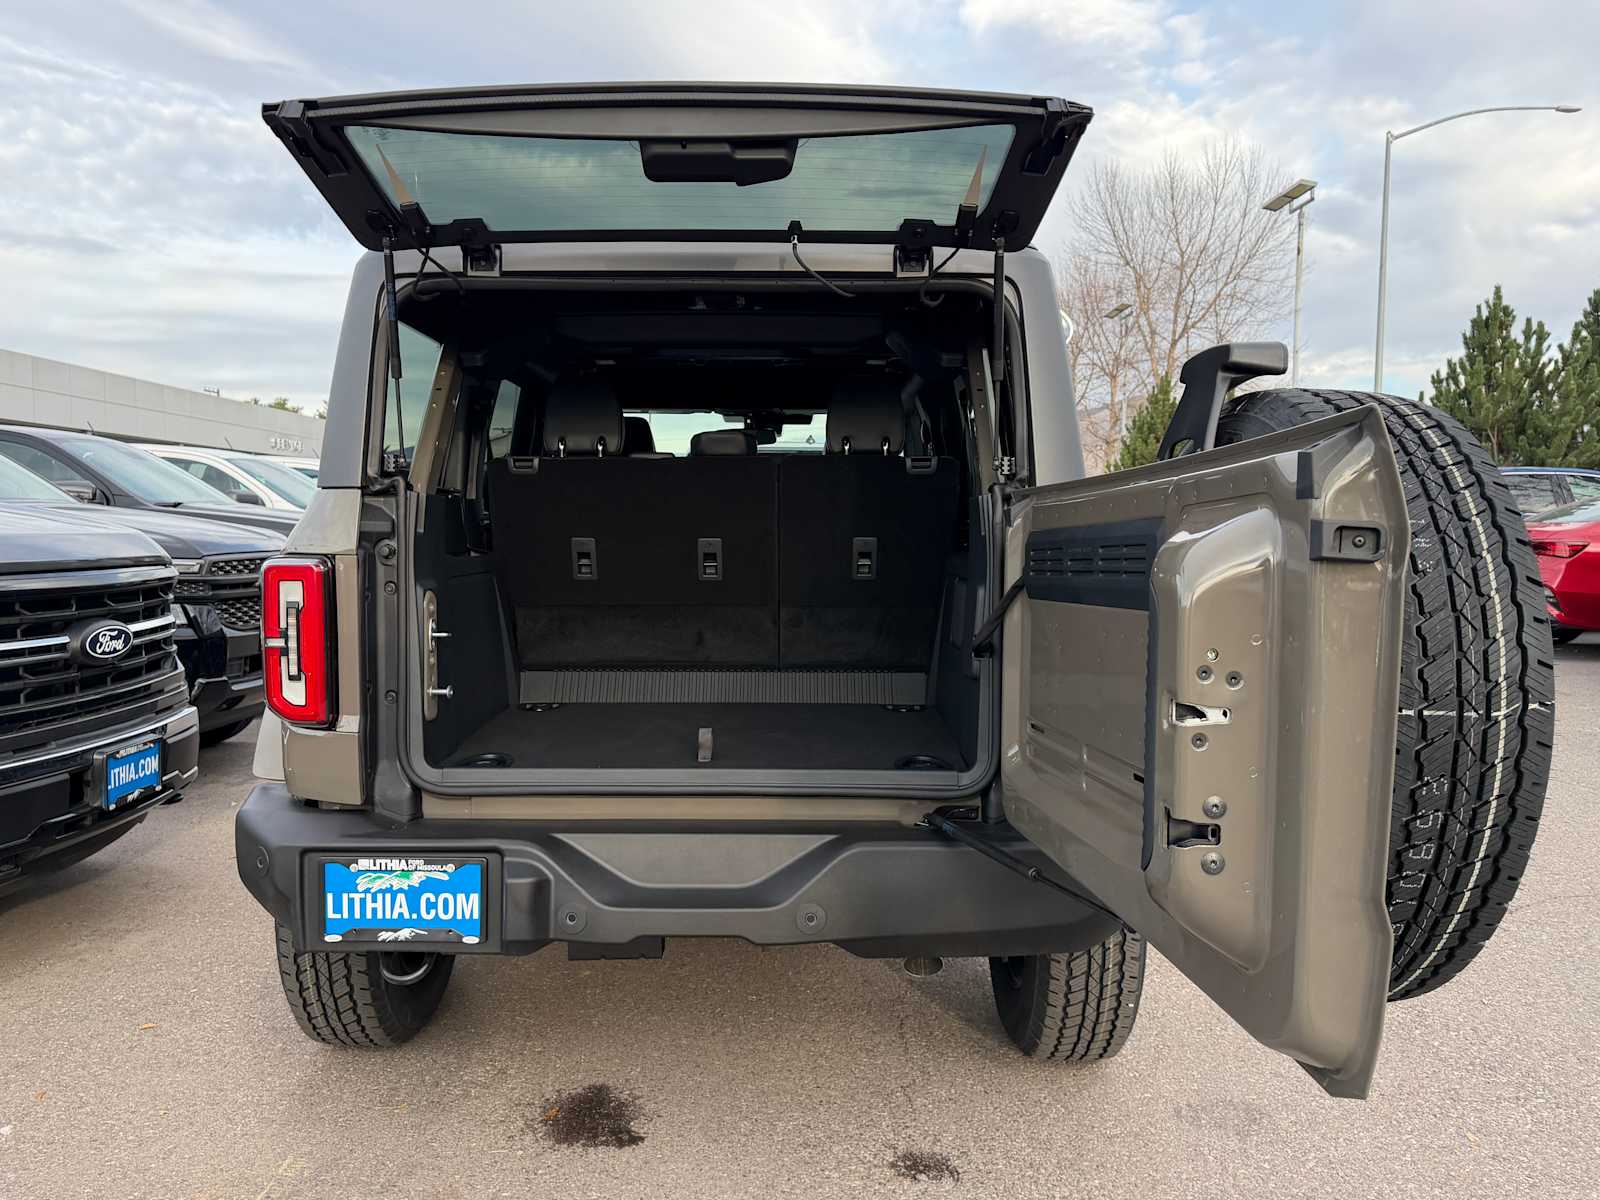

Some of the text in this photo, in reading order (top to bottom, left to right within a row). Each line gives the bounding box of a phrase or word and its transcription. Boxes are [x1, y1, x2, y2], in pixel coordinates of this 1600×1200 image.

[96, 631, 125, 653] Ford
[108, 754, 160, 790] ITHIA.COM
[369, 859, 408, 871] LITHIA
[326, 892, 480, 920] LITHIA.COM
